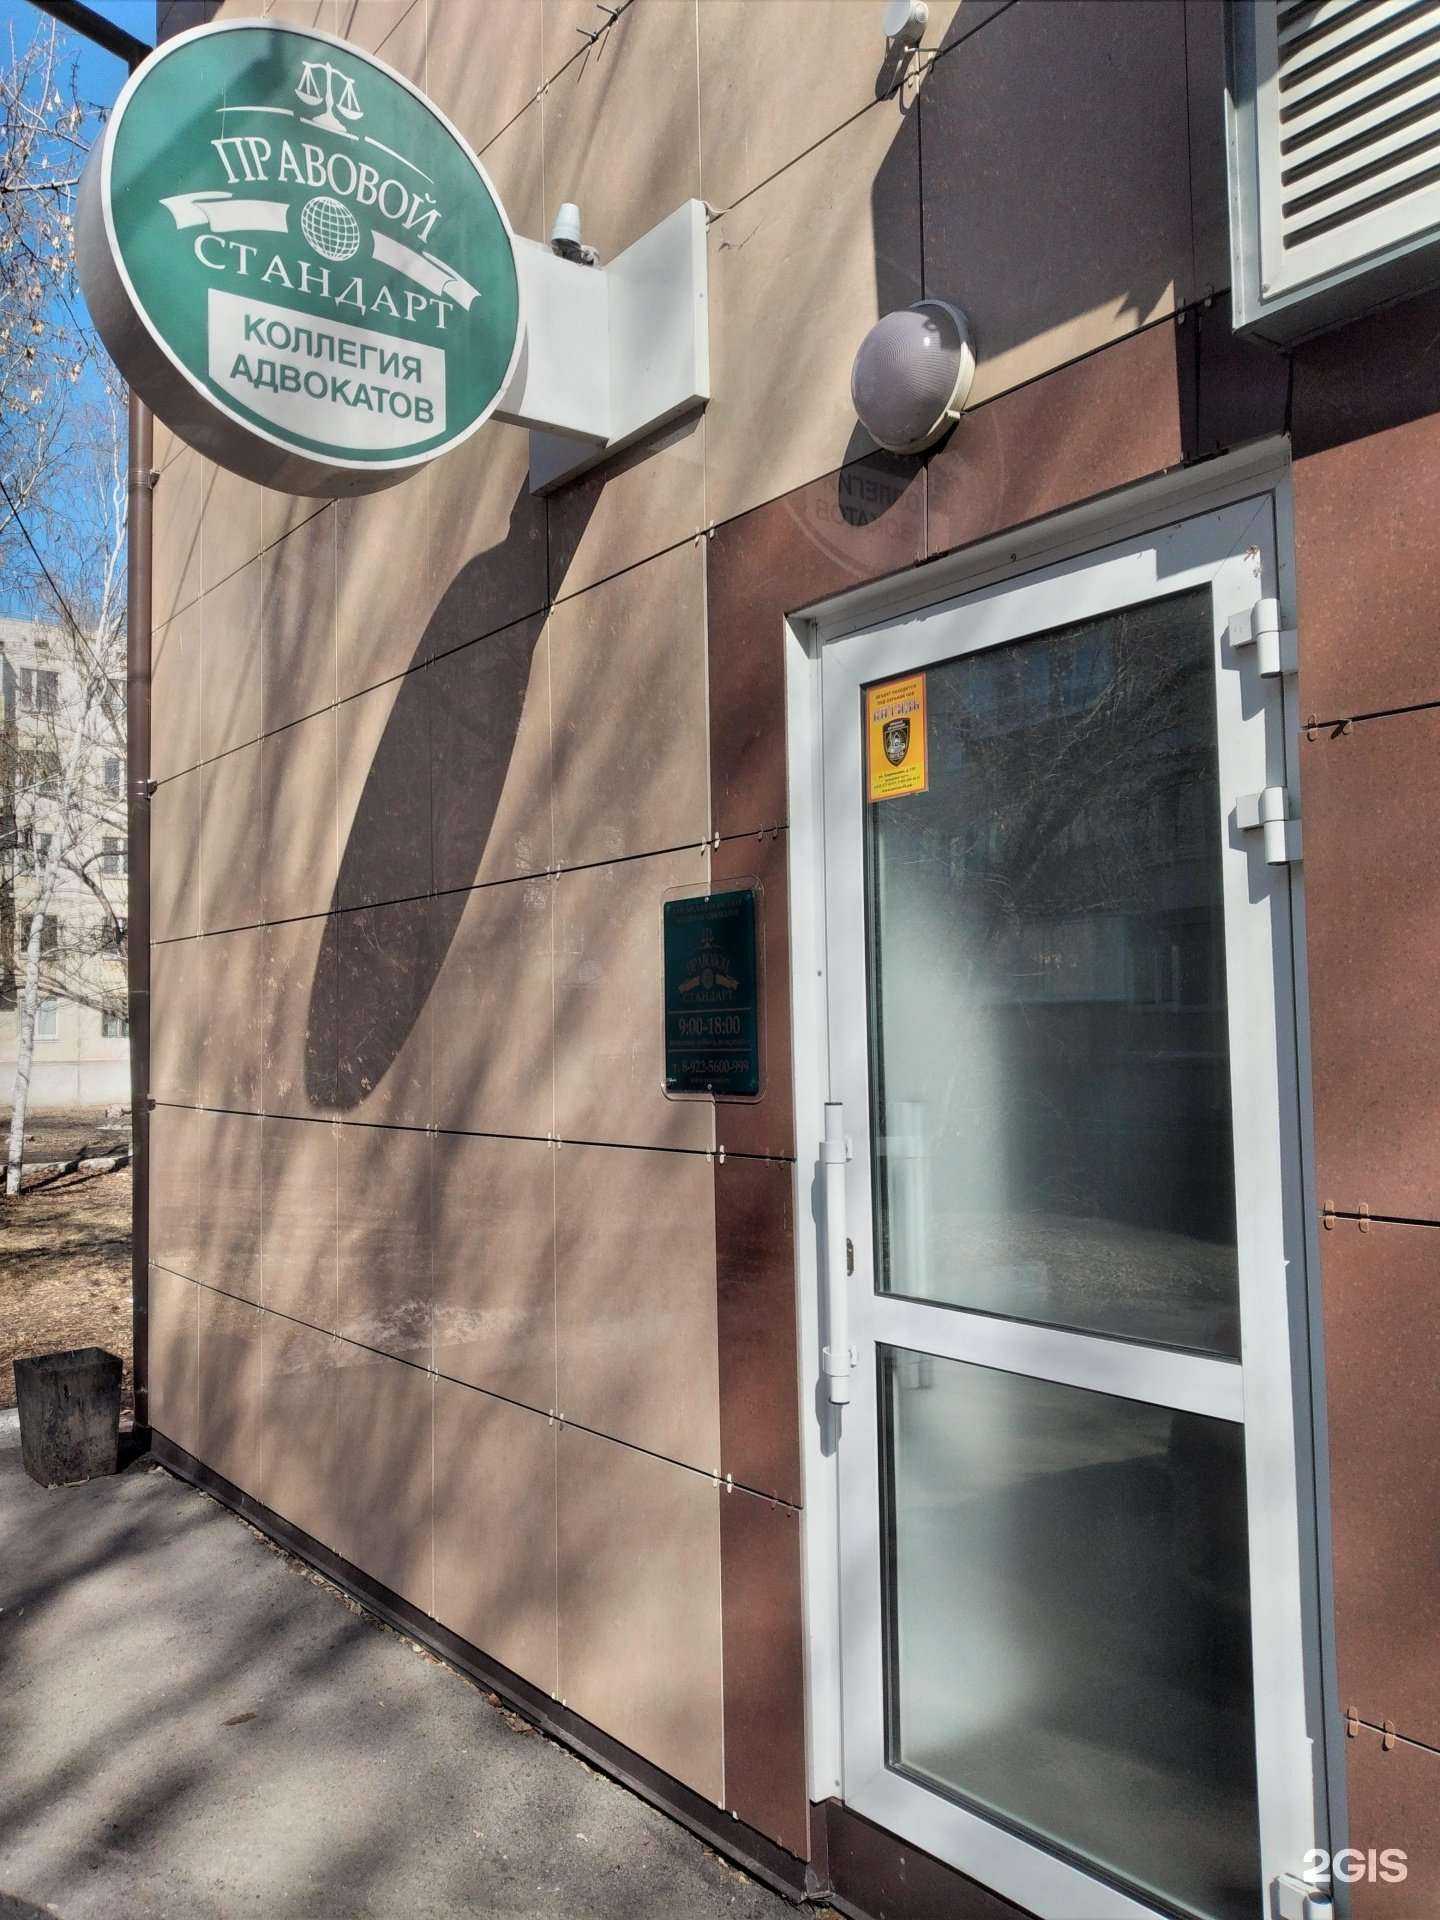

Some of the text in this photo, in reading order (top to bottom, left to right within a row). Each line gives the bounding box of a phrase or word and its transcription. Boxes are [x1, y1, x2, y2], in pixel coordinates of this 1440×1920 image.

[212, 137, 442, 243] ПРАВОВОЙ
[194, 234, 454, 329] СТАНДАРТ
[243, 313, 422, 383] КОЛЛЕГИЯ
[230, 353, 434, 424] АДВОКАТОВ
[679, 1015, 741, 1035] 9:00-18:00
